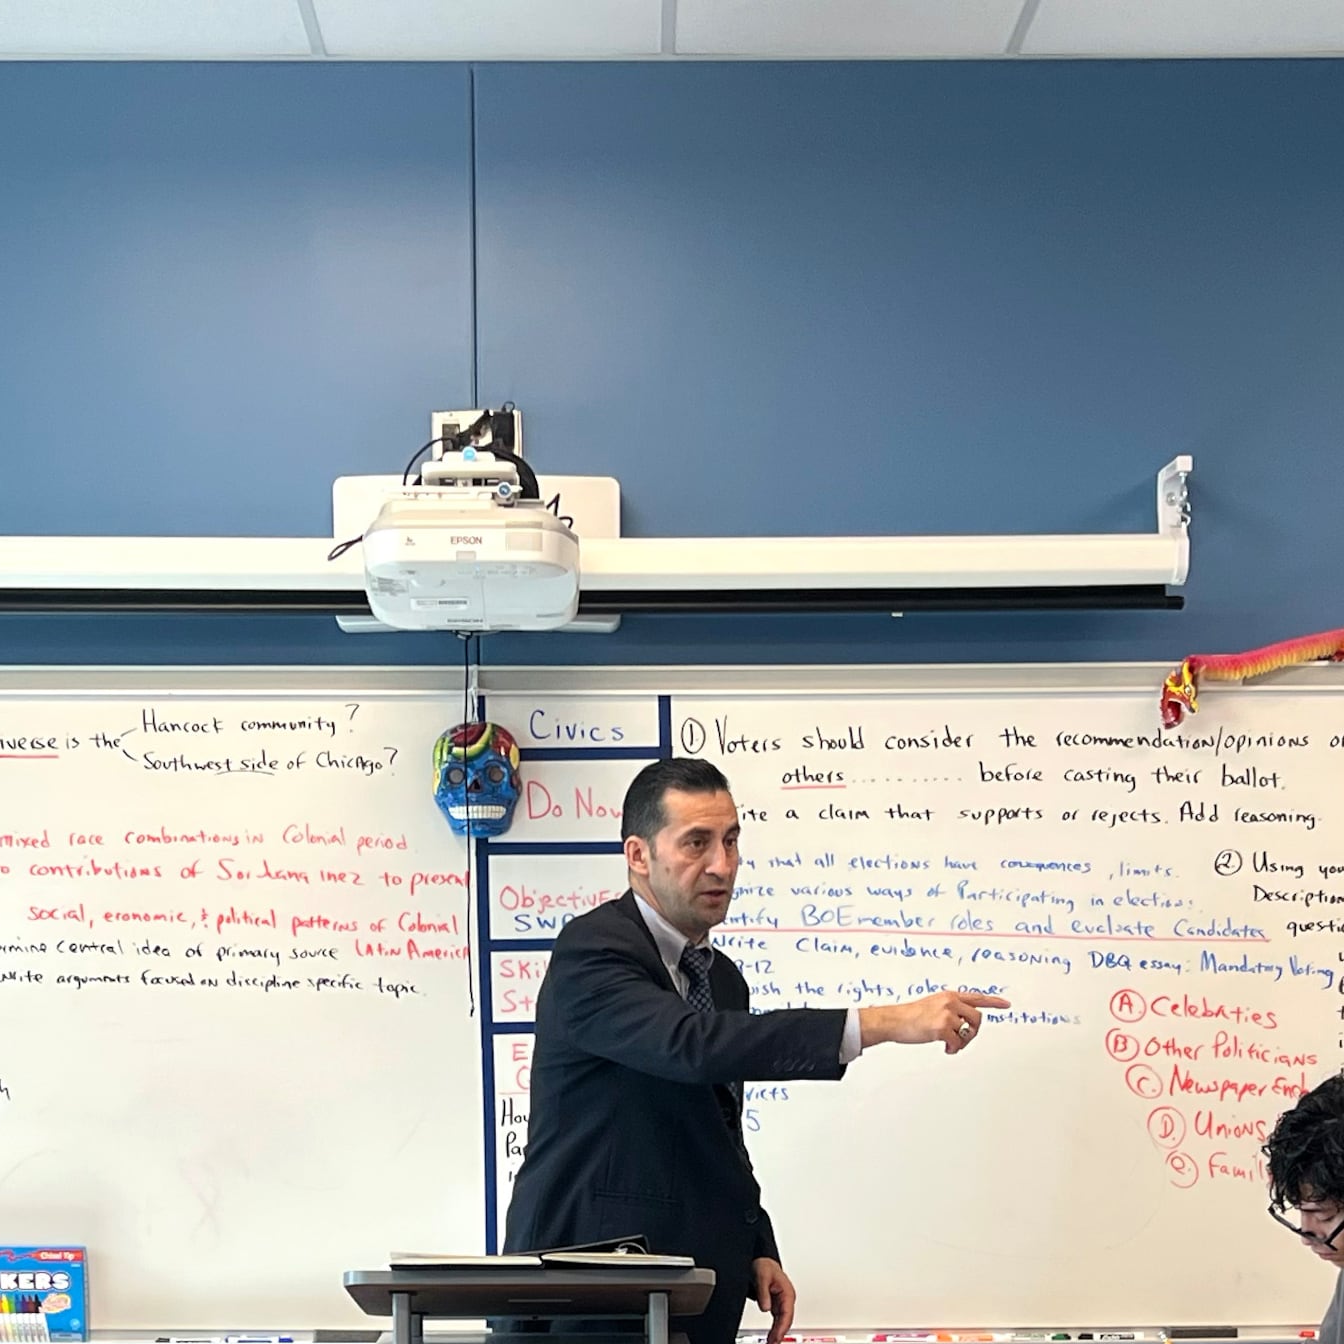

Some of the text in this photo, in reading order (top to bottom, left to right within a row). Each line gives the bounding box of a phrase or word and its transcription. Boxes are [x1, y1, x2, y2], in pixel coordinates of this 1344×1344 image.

[451, 536, 482, 545] EPSON
[142, 708, 225, 736] Hancock
[530, 710, 625, 742] Civics
[715, 714, 782, 755] Voters
[802, 726, 866, 751] should
[884, 725, 975, 750] consider
[999, 726, 1038, 749] the
[65, 733, 80, 751] is
[90, 730, 121, 752] the
[143, 750, 235, 777] Southwest
[238, 754, 275, 775] side
[287, 754, 306, 774] of
[781, 765, 845, 785] others
[978, 761, 1044, 783] before
[1063, 767, 1137, 793] casting
[1151, 766, 1203, 786] their
[527, 780, 563, 820] Do
[785, 808, 799, 819] a
[818, 804, 870, 821] claim
[885, 805, 934, 821] that
[957, 805, 1043, 825] supports
[1060, 810, 1077, 822] or
[1179, 802, 1219, 823] Add
[69, 832, 104, 846] race
[283, 823, 346, 847] Colonial
[356, 833, 408, 857] period
[29, 858, 163, 880] contributions
[180, 859, 204, 880] of
[379, 868, 402, 886] to
[814, 852, 977, 872] all elections have
[1253, 851, 1304, 878] Using
[867, 886, 913, 902] ways
[927, 884, 946, 897] of
[1091, 895, 1105, 907] in
[216, 906, 277, 934] political
[292, 908, 358, 937] patterns
[369, 918, 389, 933] of
[801, 904, 855, 927] BOE
[951, 913, 995, 932] roles
[1015, 915, 1054, 935] and
[185, 943, 205, 959] of
[216, 943, 281, 967] primary
[289, 946, 340, 961] source
[1088, 950, 1133, 971] DBQ
[1144, 1030, 1318, 1068] Other Politicians
[1169, 1064, 1265, 1103] Newspaper
